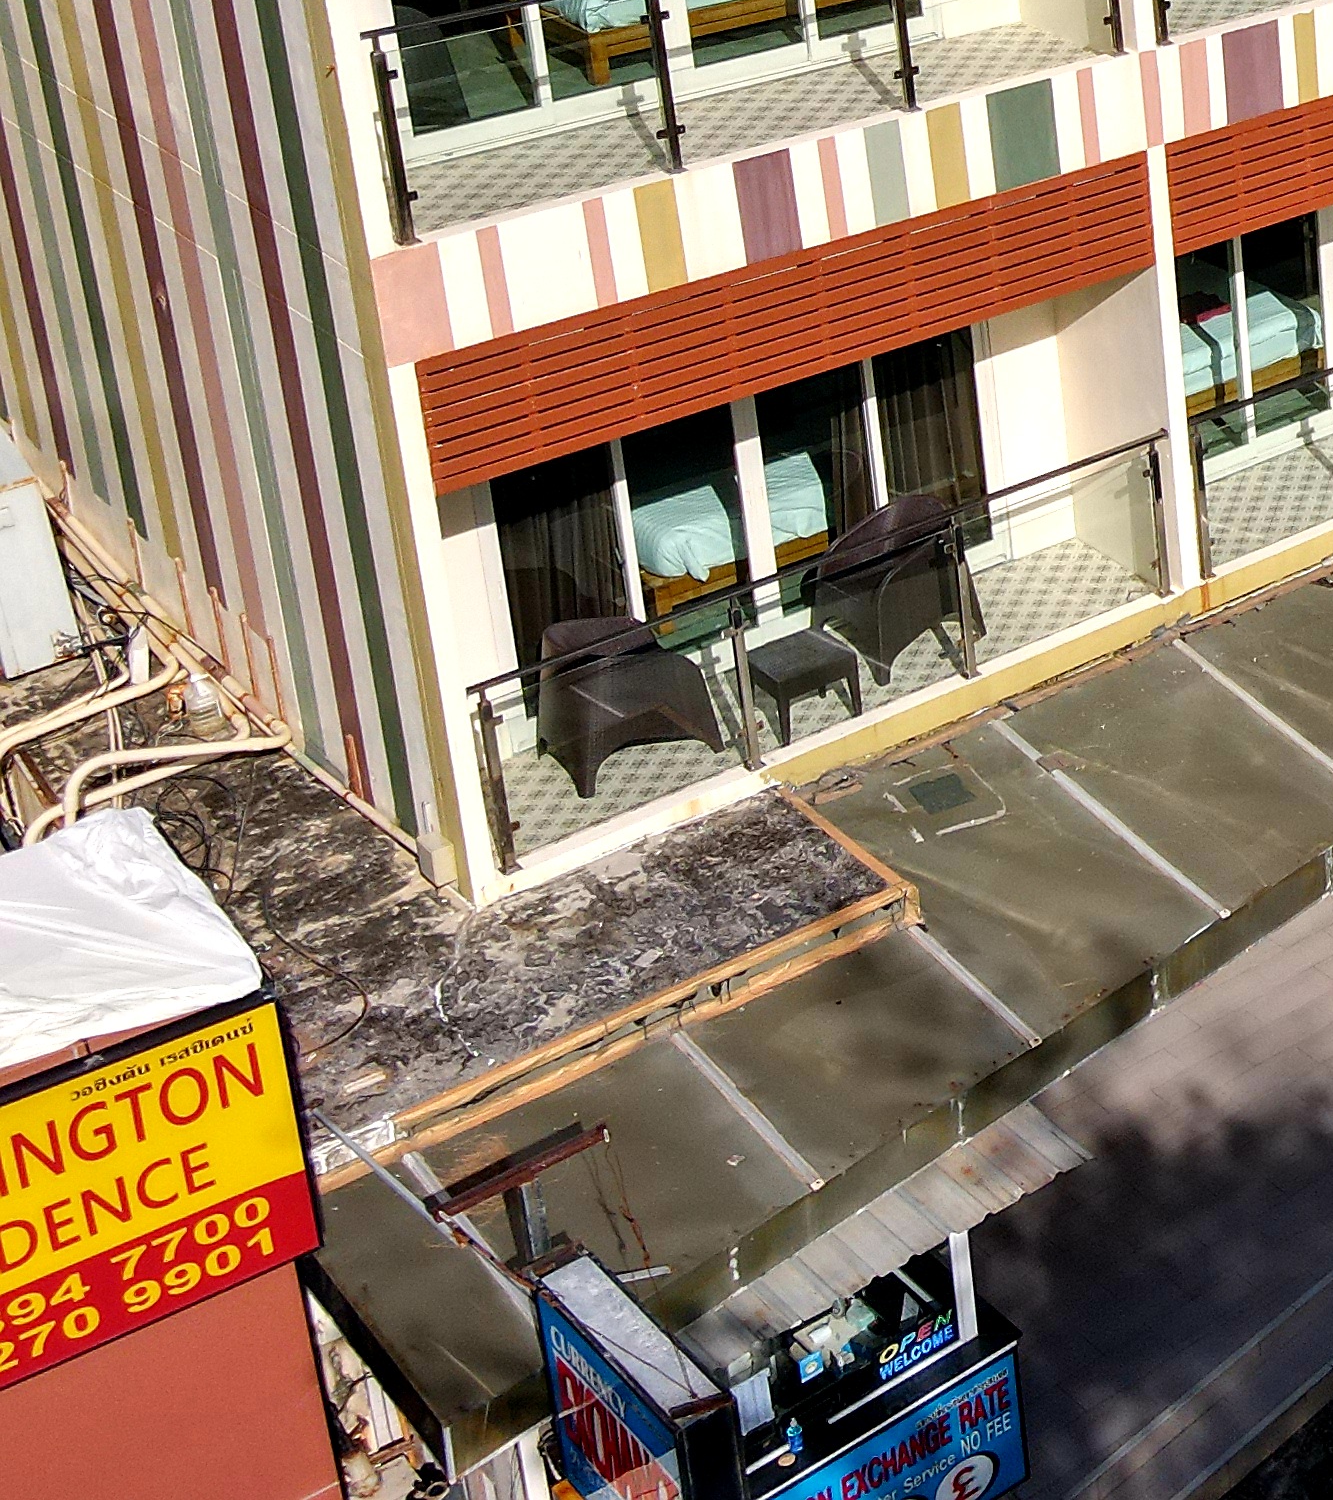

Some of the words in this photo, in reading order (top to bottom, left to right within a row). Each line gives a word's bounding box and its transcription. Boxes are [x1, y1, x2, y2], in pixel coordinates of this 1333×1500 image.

[0, 1141, 217, 1274] DENCE
[0, 1271, 91, 1335] 94
[110, 1196, 271, 1281] 7700
[121, 1227, 275, 1314] 9901
[550, 1324, 626, 1421] CURRENCY
[879, 1307, 953, 1364] OPEN
[879, 1324, 954, 1380] WELCOME
[840, 1411, 953, 1500] EXCHANGE
[957, 1376, 1011, 1435] RATE
[902, 1452, 956, 1494] Service
[959, 1430, 982, 1458] NO
[985, 1410, 1012, 1438] FEE
